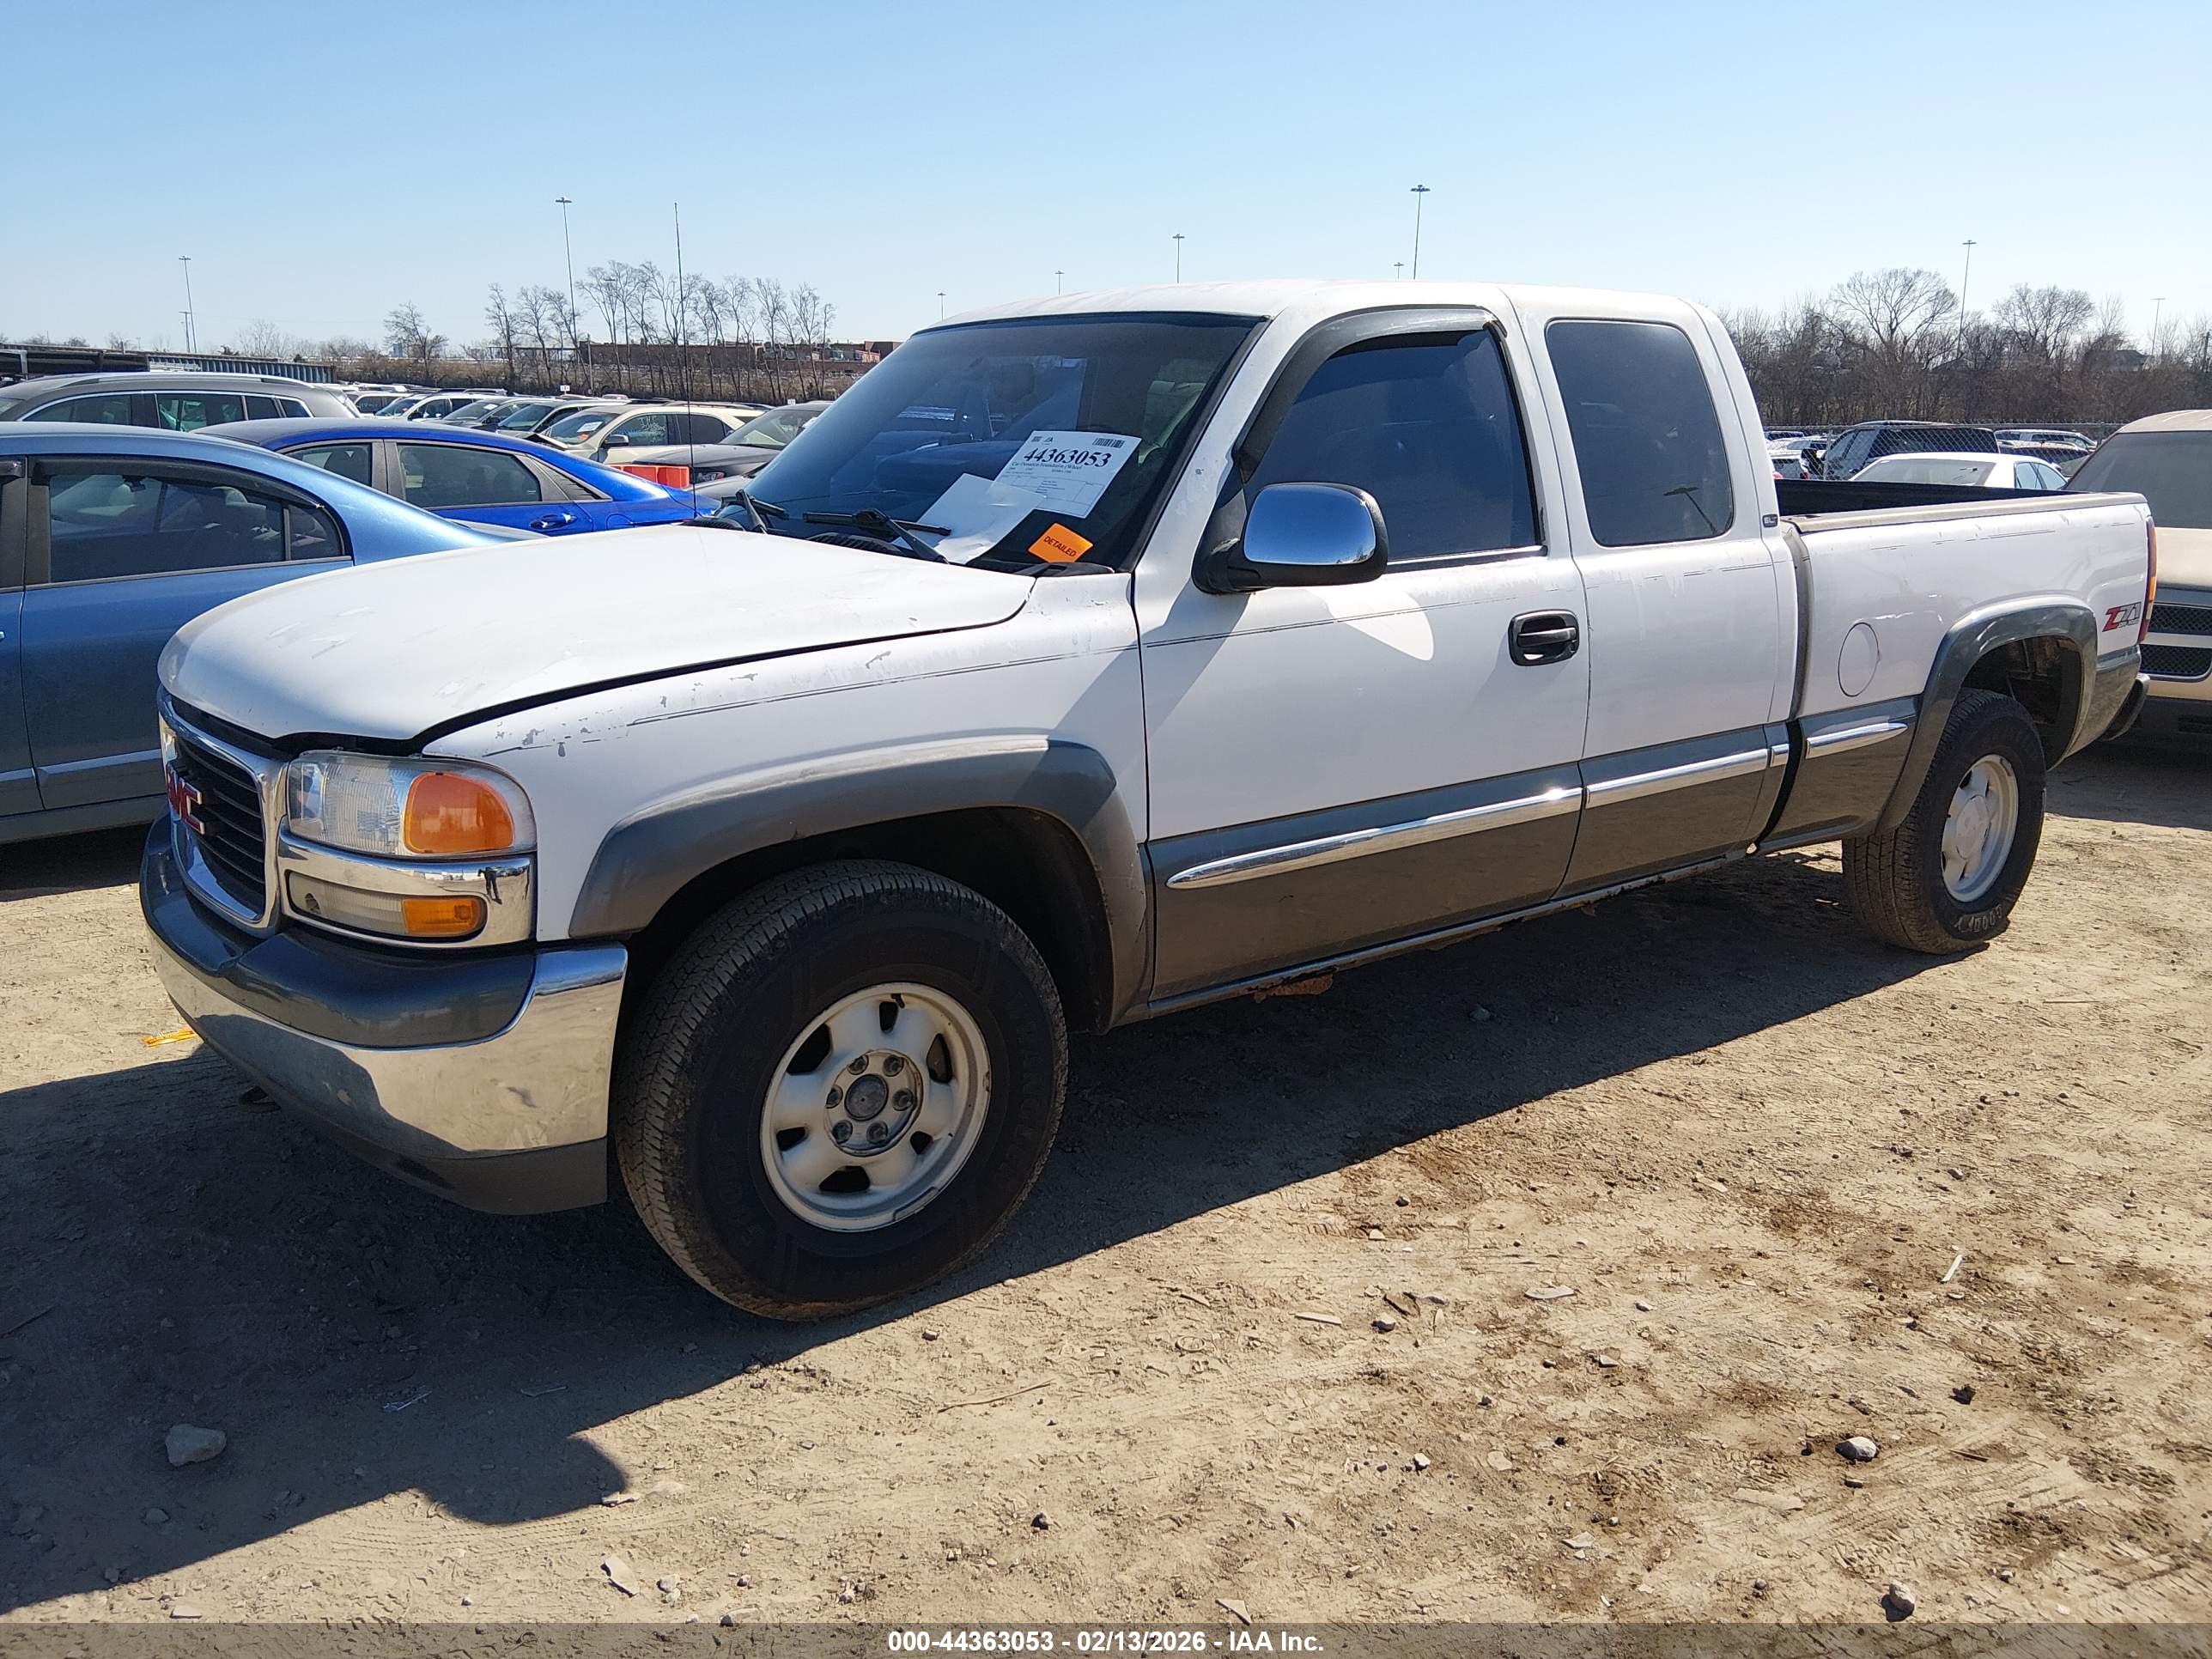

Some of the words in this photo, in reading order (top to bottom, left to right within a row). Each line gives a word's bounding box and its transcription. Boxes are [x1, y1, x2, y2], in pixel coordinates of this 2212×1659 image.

[1024, 447, 1112, 467] 44363053
[1043, 536, 1077, 557] DETAILED
[2102, 601, 2142, 632] Z71
